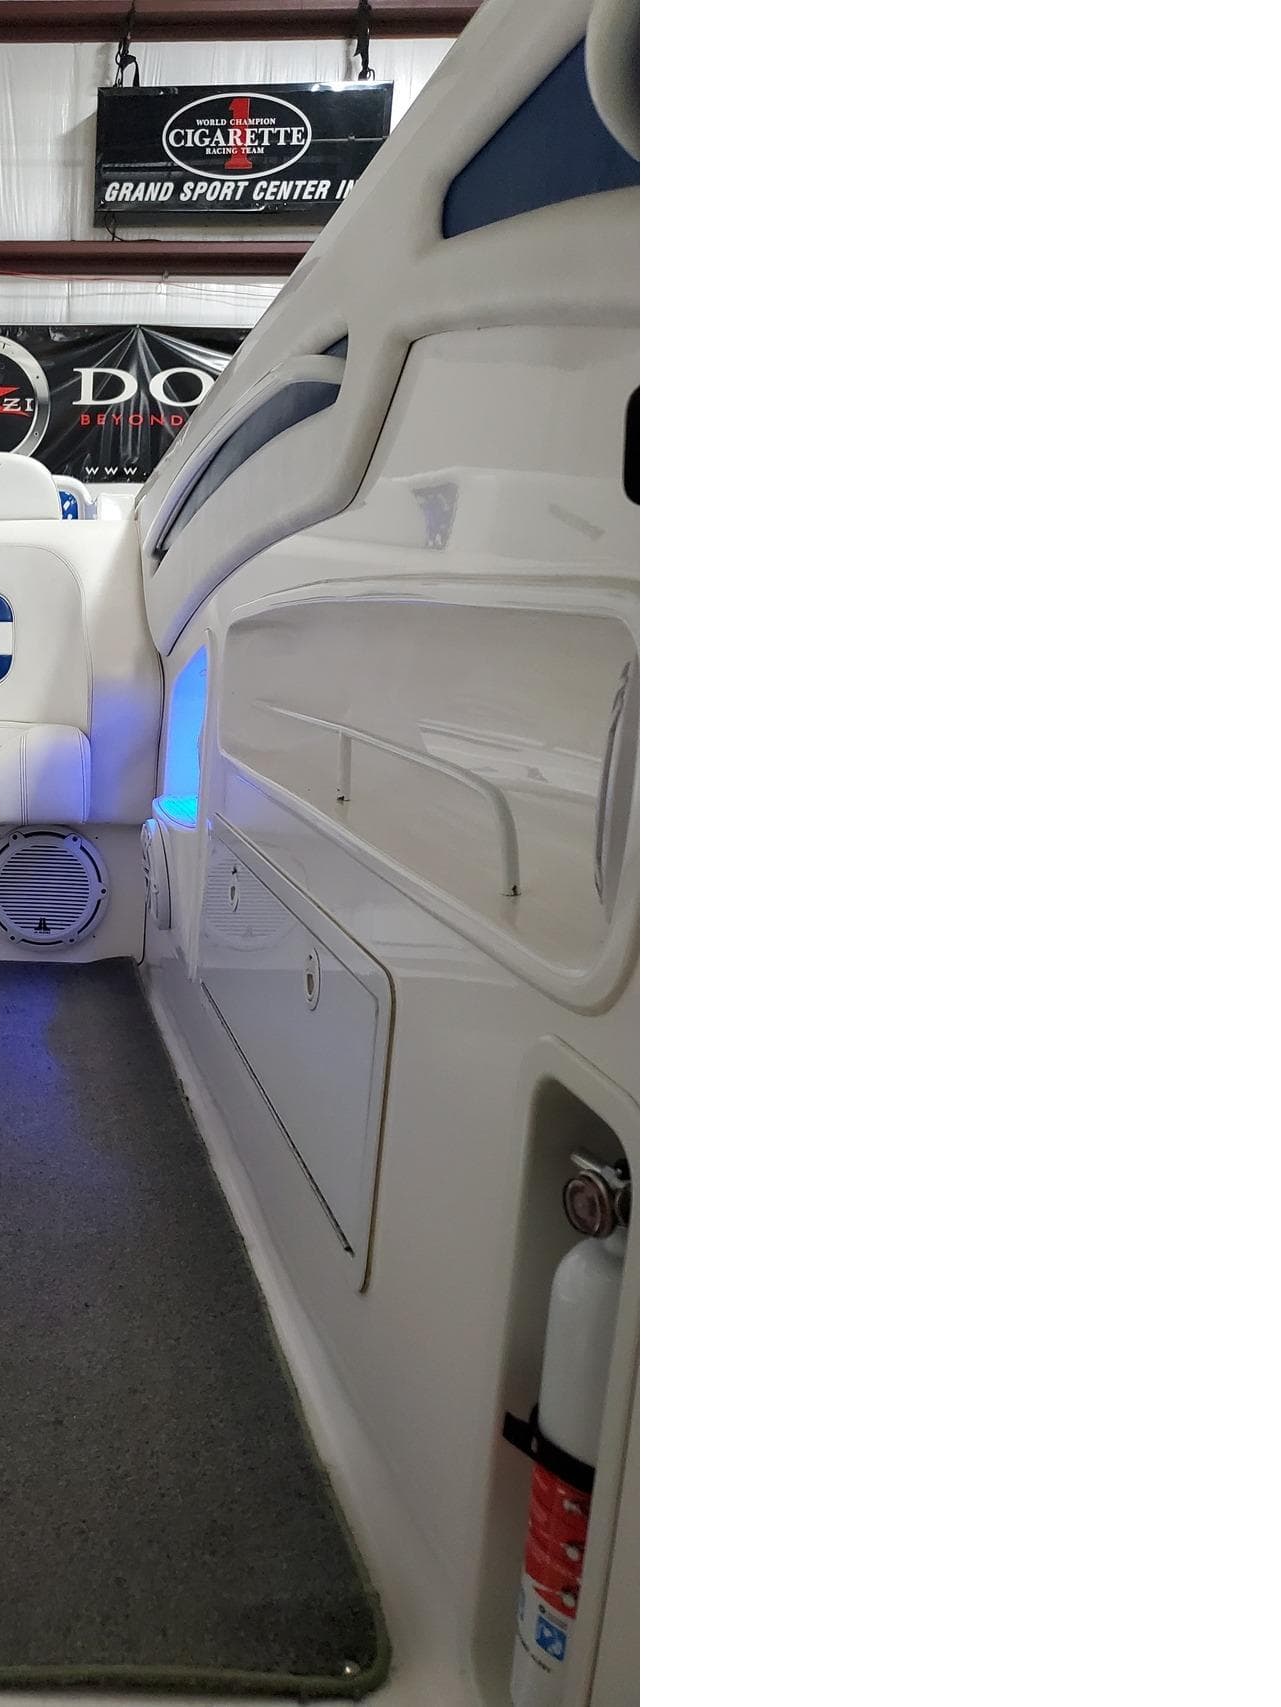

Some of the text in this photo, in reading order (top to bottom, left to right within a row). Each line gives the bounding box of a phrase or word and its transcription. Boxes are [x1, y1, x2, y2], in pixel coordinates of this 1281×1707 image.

[229, 117, 276, 126] CHAMPION
[168, 127, 306, 147] CIGARETTE
[205, 147, 238, 155] RACING
[104, 181, 174, 202] GRAND
[180, 180, 246, 201] SPORT
[252, 179, 331, 200] CENTER
[80, 414, 184, 426] BEYOND
